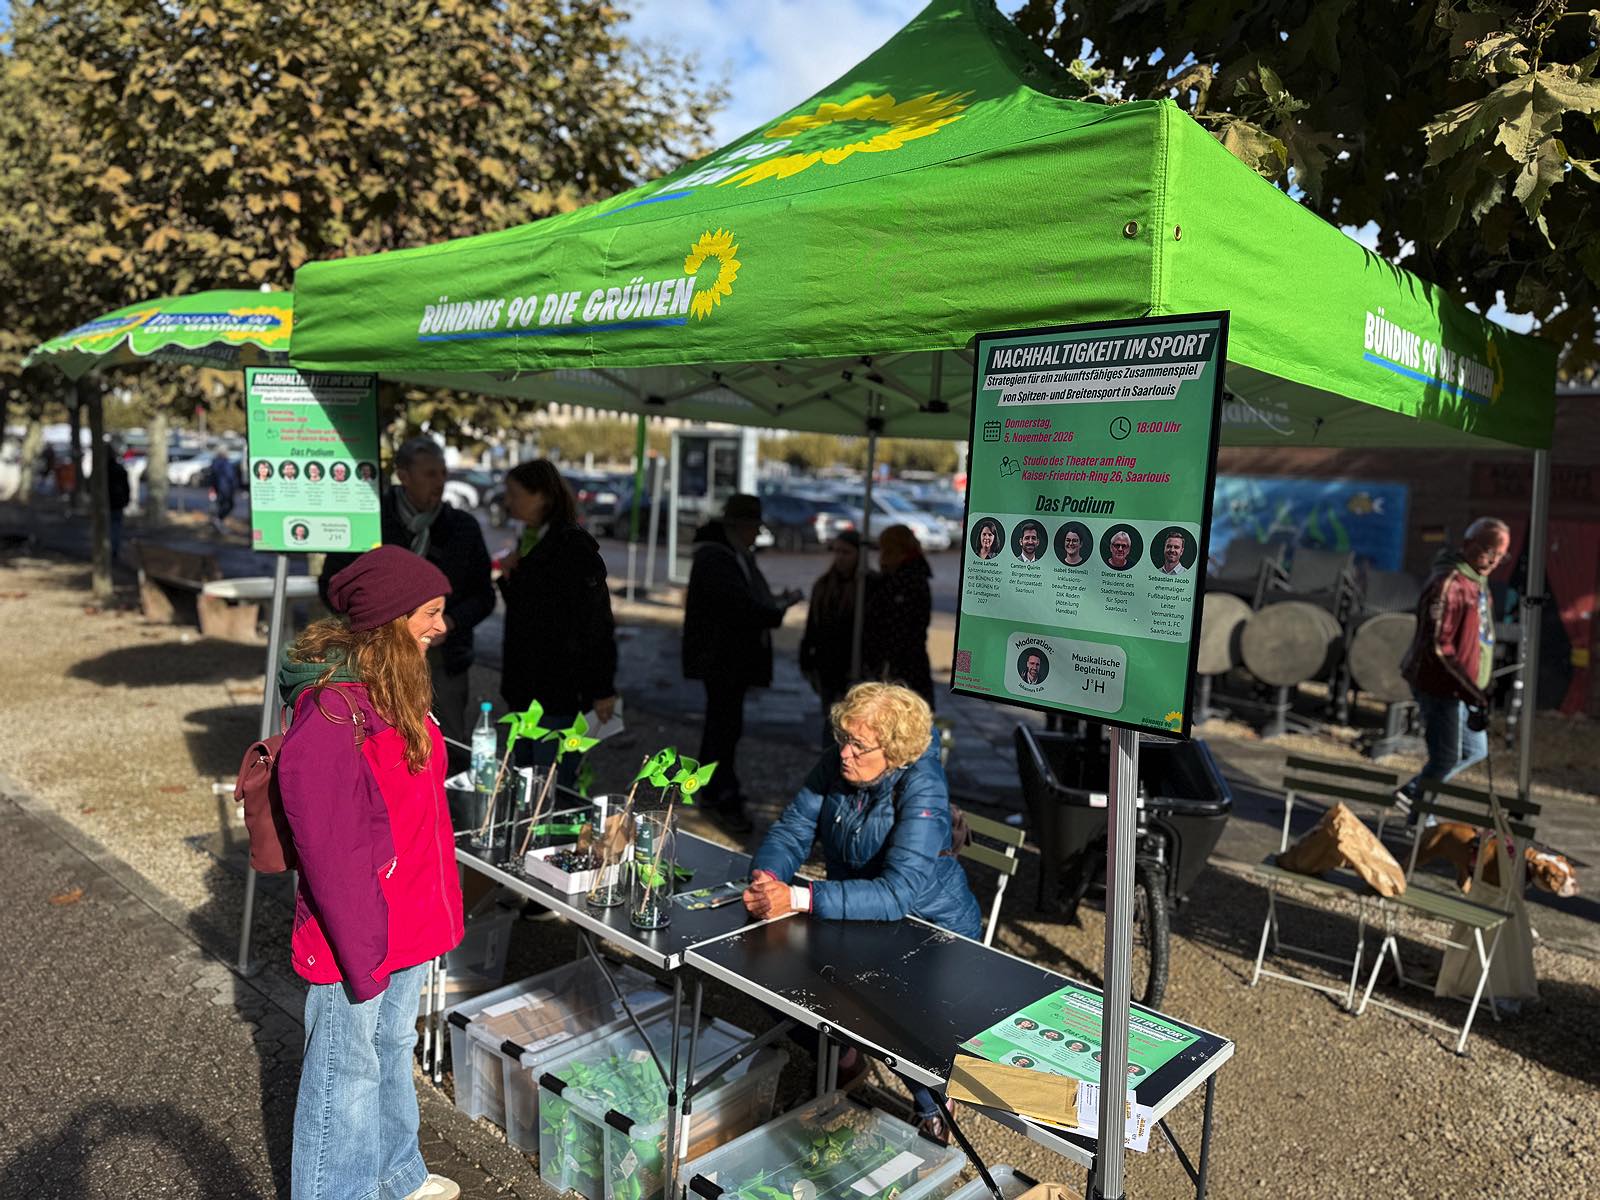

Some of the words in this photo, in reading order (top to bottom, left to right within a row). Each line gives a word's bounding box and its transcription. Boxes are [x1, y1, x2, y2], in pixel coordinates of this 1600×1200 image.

[418, 296, 505, 334] BÜNDNIS
[506, 297, 537, 328] 90
[539, 291, 582, 326] DIE
[583, 276, 697, 322] GRÜNEN
[144, 325, 177, 334] DIE
[1364, 306, 1421, 369] BÜNDNIS
[1422, 339, 1437, 376] 90
[1439, 346, 1456, 383] DIE
[991, 339, 1124, 369] NACHHALTIGKEIT
[1124, 338, 1147, 360] IM
[1148, 333, 1210, 357] SPORT
[987, 373, 1027, 387] Strategien
[1027, 372, 1040, 384] für
[1040, 372, 1053, 383] ein
[1053, 368, 1123, 383] zukunftsfähiges
[1123, 364, 1197, 379] Zusammenspiel
[1003, 393, 1017, 402] von
[1017, 390, 1049, 403] Spitzen-
[1049, 389, 1065, 400] und
[1066, 387, 1121, 400] Breitensport
[1121, 387, 1130, 397] in
[1131, 384, 1176, 396] Saarlouis
[1004, 418, 1052, 430] Donnerstag,
[1136, 422, 1163, 433] 18:00
[1164, 422, 1182, 433] Uhr
[1003, 433, 1012, 443] 5.
[1013, 432, 1053, 443] November
[1053, 431, 1074, 442] 2026
[290, 448, 304, 457] Das
[305, 448, 334, 457] Podium
[1023, 456, 1050, 467] Studio
[1050, 456, 1064, 466] des
[1065, 456, 1100, 467] Theater
[1100, 458, 1115, 467] am
[1115, 456, 1137, 468] Ring
[1021, 471, 1109, 484] Kaiser-Friedrich-Ring
[1110, 472, 1124, 483] 26,
[1125, 472, 1171, 483] Saarlouis
[1035, 495, 1059, 513] Das
[1061, 496, 1116, 515] Podium
[1148, 575, 1173, 583] Sebastian
[1100, 588, 1135, 596] Stadtverbands
[1104, 605, 1127, 613] Saarlouis
[1151, 611, 1184, 620] Vermarktung
[1015, 637, 1055, 655] Moderation:
[1072, 653, 1120, 668] Musikalische
[1074, 664, 1116, 679] Begleitung
